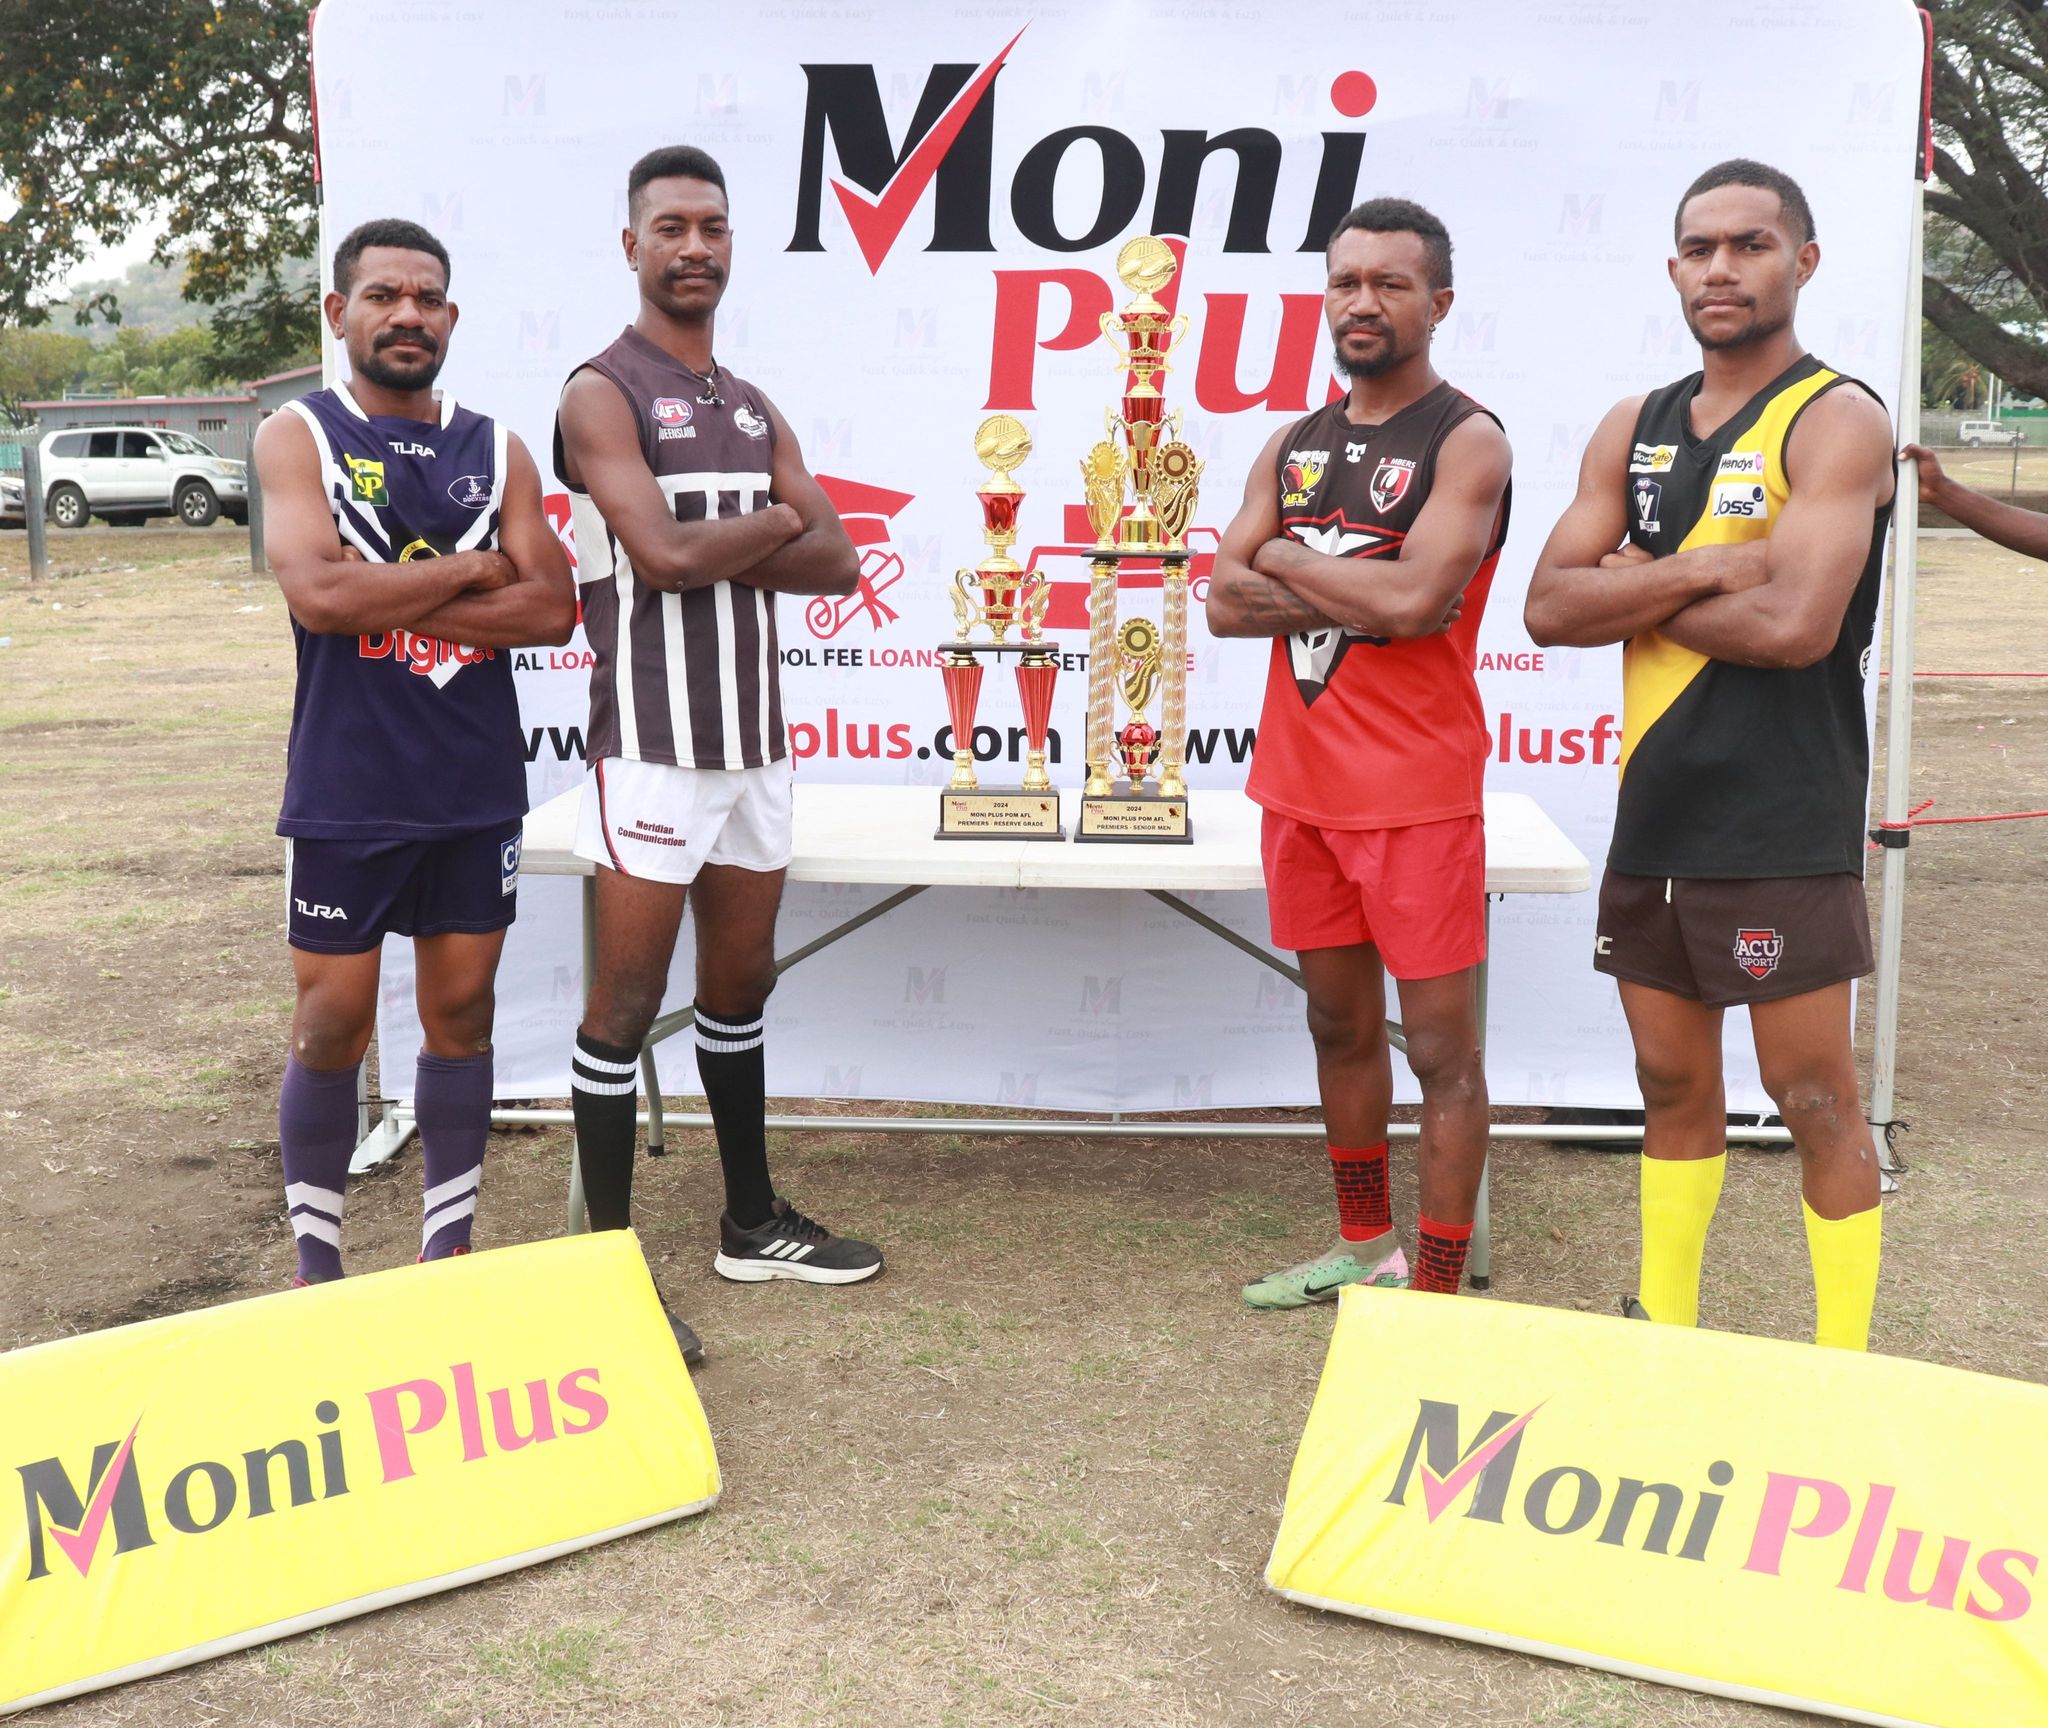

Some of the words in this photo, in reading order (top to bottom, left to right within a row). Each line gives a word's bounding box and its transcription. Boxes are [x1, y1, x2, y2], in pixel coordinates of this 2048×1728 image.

[785, 20, 1377, 276] Moni
[981, 236, 1347, 414] Plu
[660, 404, 689, 419] AFL
[1721, 457, 1753, 471] Wendys
[1284, 492, 1306, 506] AFL
[824, 649, 863, 667] FEE
[870, 649, 946, 668] LOANS
[1475, 653, 1544, 672] ANGE
[617, 826, 687, 847] Communications
[636, 819, 674, 835] Meridian
[295, 897, 348, 920] TURA
[1736, 939, 1780, 957] ACU
[1742, 956, 1774, 967] SPORT
[15, 1404, 350, 1581] Moni
[365, 1361, 609, 1484] Plus
[1383, 1393, 1734, 1562] Moni
[1741, 1471, 2039, 1621] Plus
